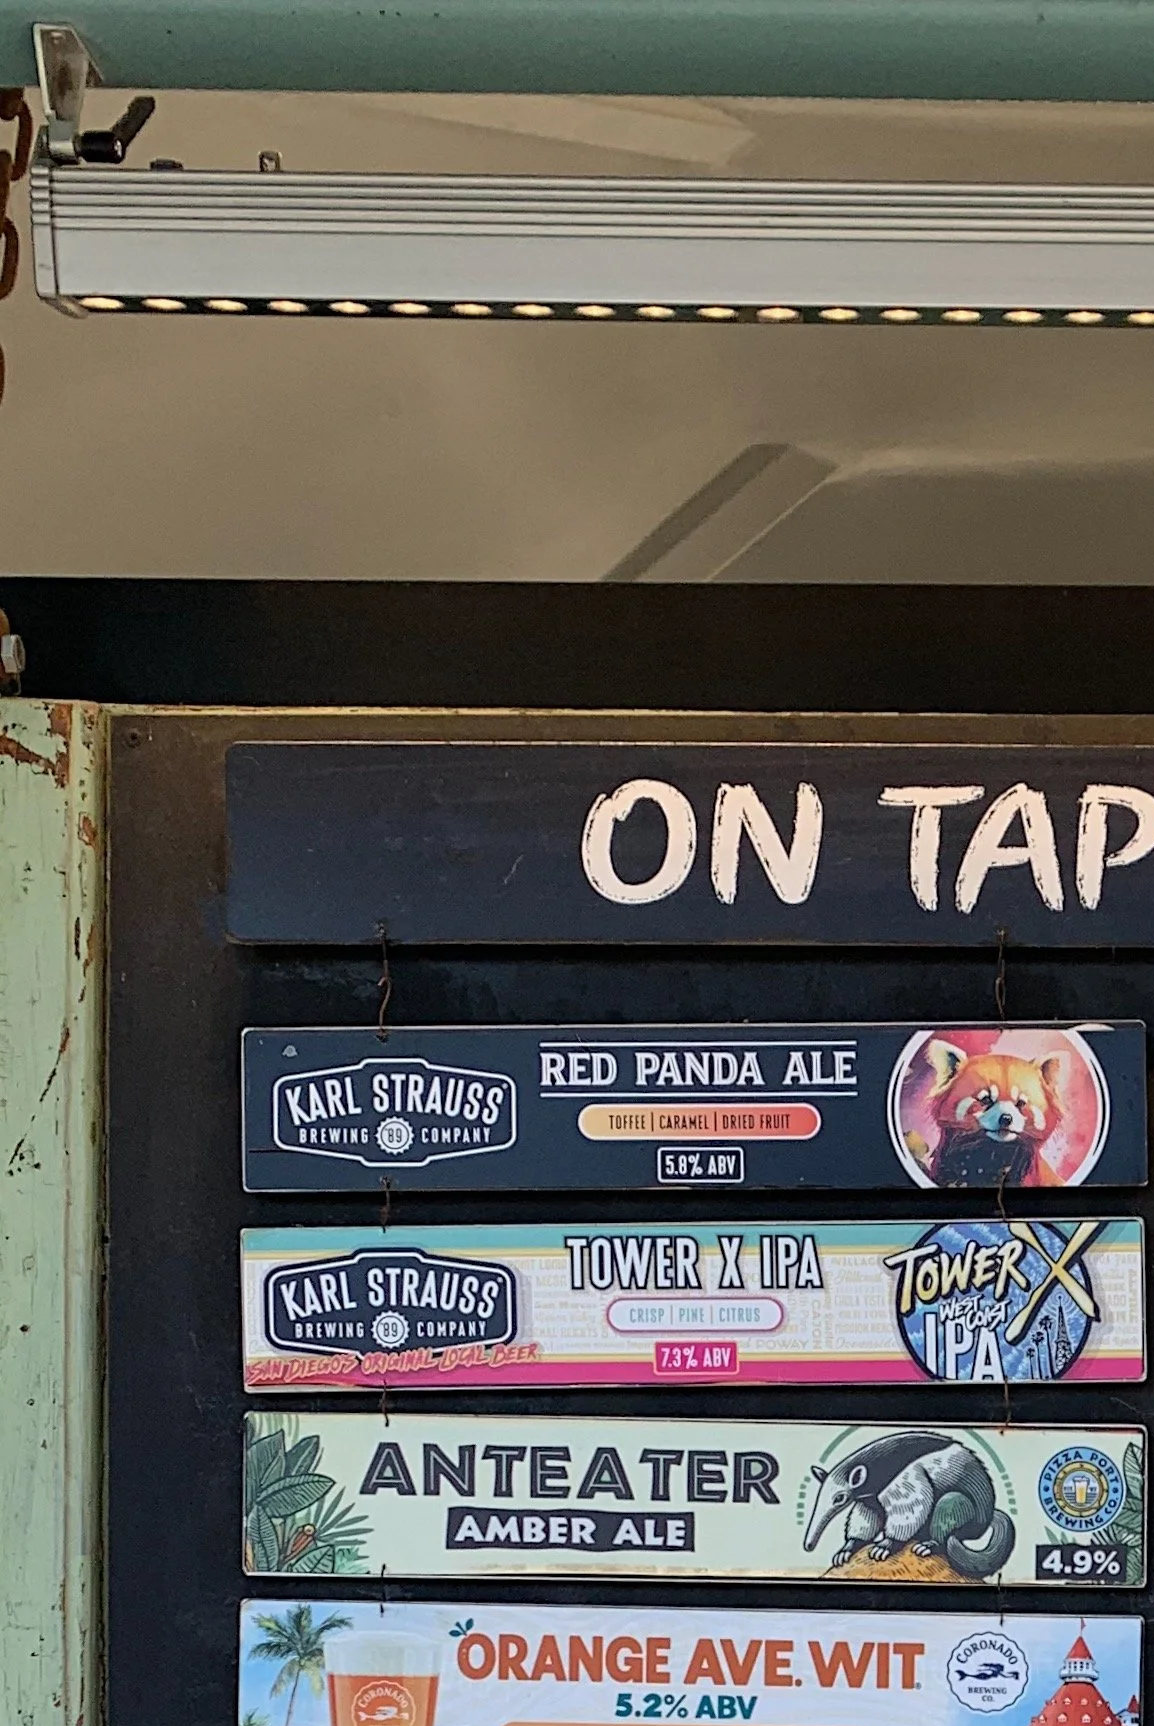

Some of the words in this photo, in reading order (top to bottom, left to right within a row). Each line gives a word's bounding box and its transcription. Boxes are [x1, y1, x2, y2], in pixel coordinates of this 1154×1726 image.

[581, 778, 823, 905] ON
[540, 1051, 617, 1086] RED
[635, 1051, 765, 1086] PANDA
[782, 1050, 857, 1085] ALE
[285, 1076, 362, 1125] KARL
[372, 1073, 504, 1125] STRAUSS
[299, 1128, 369, 1144] BREWING
[421, 1127, 491, 1144] COMPANY
[609, 1114, 646, 1130] TOFFEE
[659, 1113, 709, 1130] CARAMEL
[722, 1113, 755, 1130] DRIED
[760, 1113, 791, 1129] FRUIT
[665, 1152, 702, 1177] 5.8%
[708, 1154, 736, 1175] ABV
[564, 1235, 703, 1290] TOWER
[717, 1235, 745, 1290] X
[759, 1234, 825, 1289] IPA
[280, 1270, 357, 1321] KARL
[367, 1267, 499, 1319] STRAUSS
[883, 1239, 1031, 1317] TOWER
[1004, 1221, 1102, 1345] X
[629, 1307, 665, 1324] CRISP
[679, 1307, 705, 1323] PINE
[719, 1306, 761, 1322] CITRUS
[938, 1293, 984, 1324] WEST
[295, 1321, 365, 1339] BREWING
[417, 1321, 487, 1338] COMPANY
[661, 1346, 698, 1369] 7.3%
[703, 1347, 732, 1367] ABV
[923, 1311, 1006, 1380] IPA
[249, 1359, 283, 1384] SAN
[361, 1348, 434, 1375] ORIGINAL
[439, 1346, 489, 1371] LOCAL
[489, 1343, 540, 1368] BEER
[360, 1441, 780, 1505] ANTEATER
[1044, 1450, 1083, 1481] PIZZA
[1090, 1453, 1119, 1483] PORT
[1044, 1497, 1104, 1528] BREWING
[454, 1514, 596, 1545] AMBER
[614, 1516, 686, 1546] ALE
[1042, 1549, 1121, 1575] 4.9%
[457, 1631, 671, 1684] ORANGE
[683, 1637, 803, 1688] AVE.
[808, 1641, 925, 1690] WIT
[956, 1639, 1019, 1665] CORONADO
[614, 1692, 689, 1719] 5.2%
[695, 1695, 758, 1720] ABV
[968, 1686, 1007, 1695] BREWING
